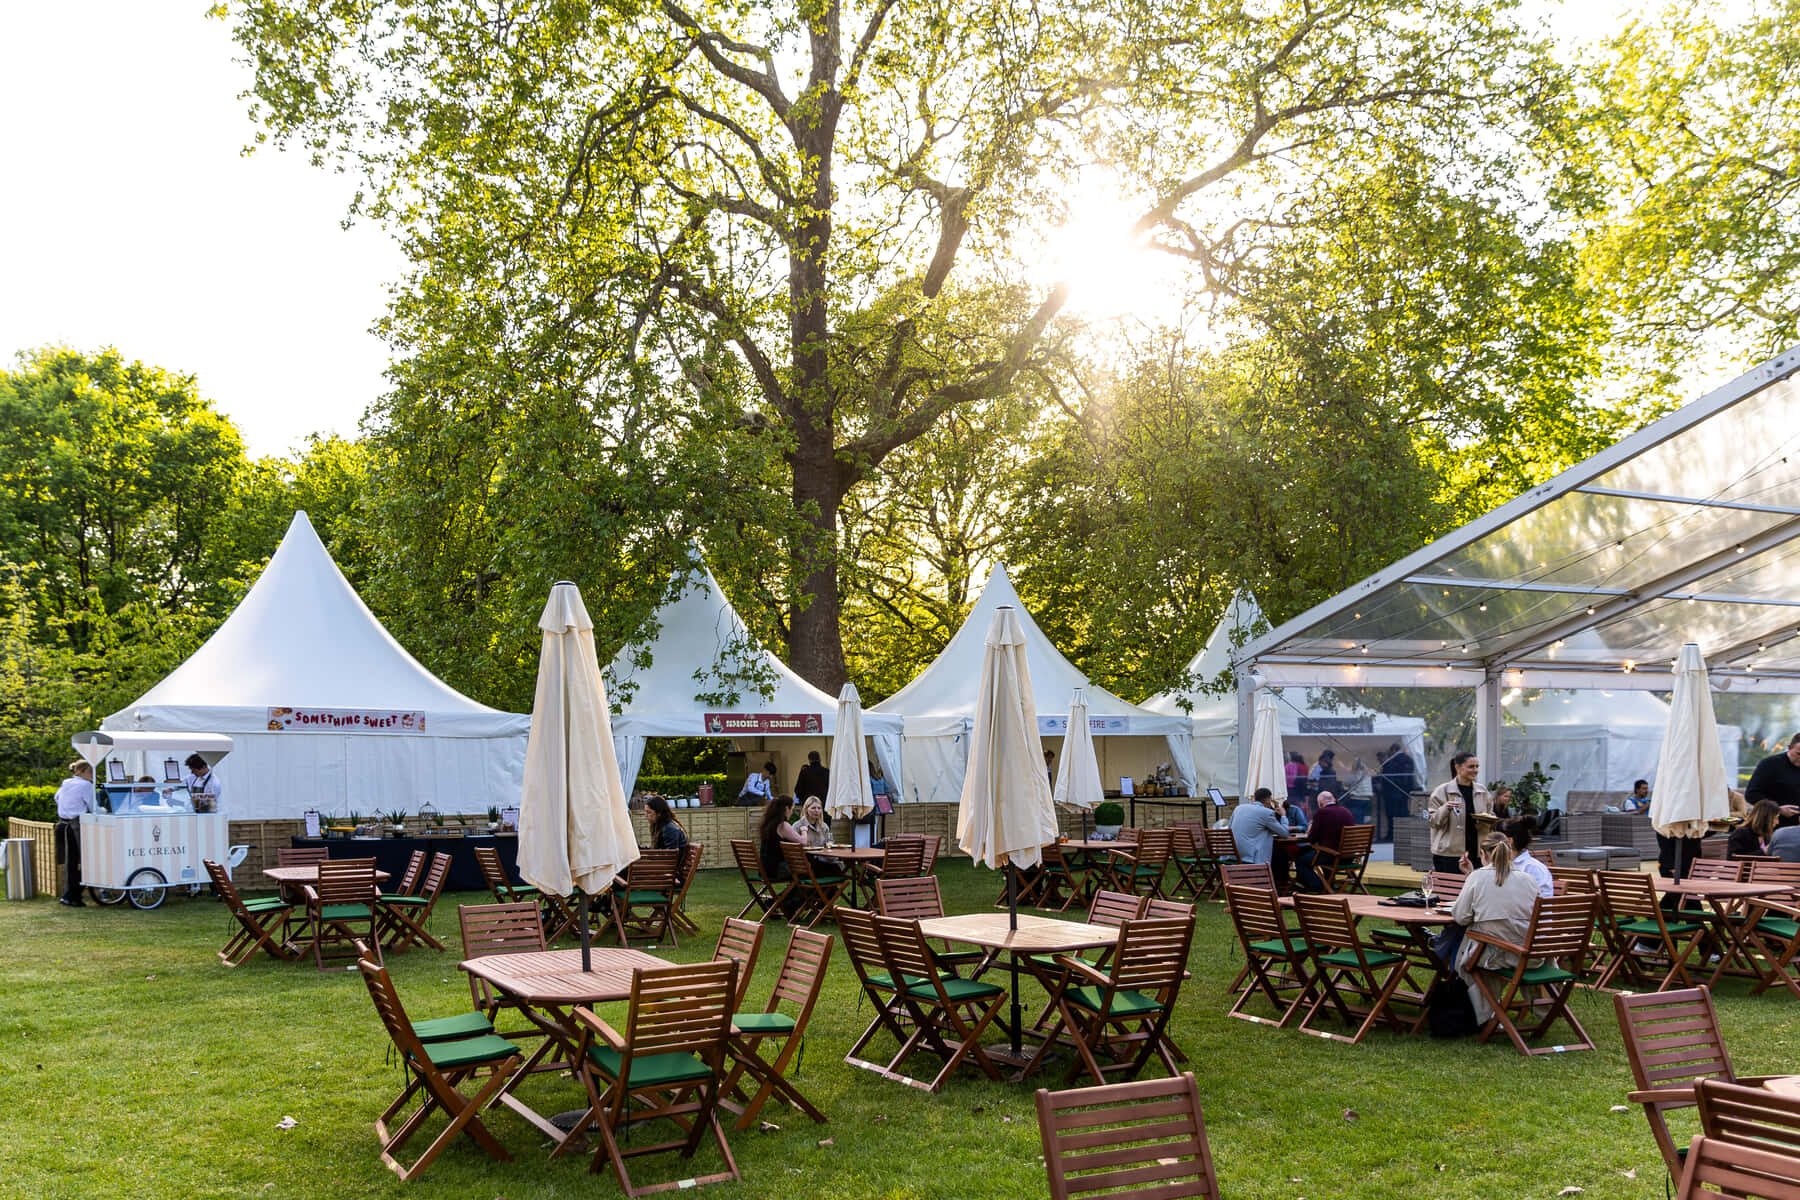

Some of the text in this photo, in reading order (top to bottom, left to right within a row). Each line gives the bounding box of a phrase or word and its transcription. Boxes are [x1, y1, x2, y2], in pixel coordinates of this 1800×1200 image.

[295, 711, 398, 728] SOMETHING SWEET
[726, 719, 759, 728] SMOKE
[770, 720, 801, 728] EMBER
[128, 846, 185, 857] ICE CREAM
